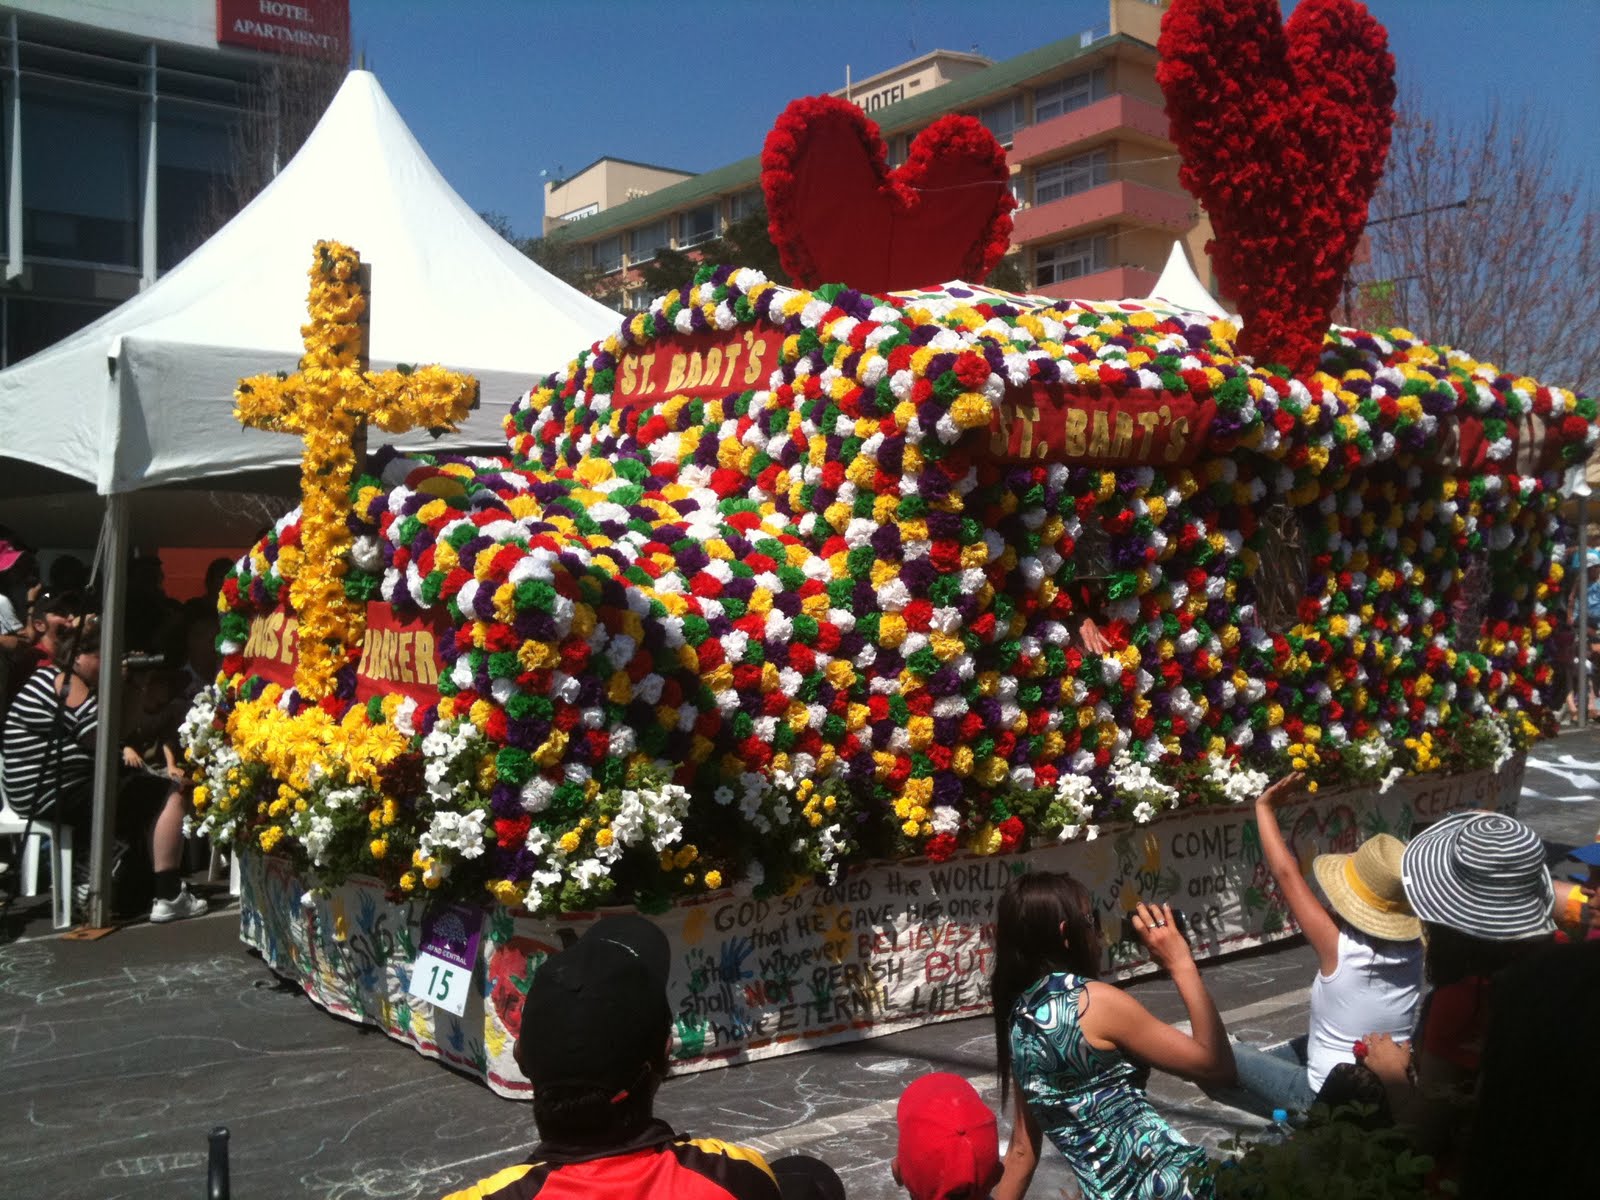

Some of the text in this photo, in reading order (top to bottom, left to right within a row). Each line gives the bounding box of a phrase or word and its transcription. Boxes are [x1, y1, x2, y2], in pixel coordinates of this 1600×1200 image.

[620, 331, 766, 395] ST. BART'S
[1064, 405, 1190, 462] BART'S
[357, 628, 438, 685] PRAYER
[1172, 824, 1237, 862] COME
[714, 899, 770, 931] GOD
[929, 859, 1010, 894] WORLD
[1188, 864, 1227, 897] and
[750, 917, 790, 949] that
[795, 912, 827, 938] HE
[836, 904, 894, 932] GAVE
[949, 900, 982, 918] one
[428, 964, 454, 1001] 15
[925, 948, 994, 985] BUT
[911, 980, 968, 1014] LIFE
